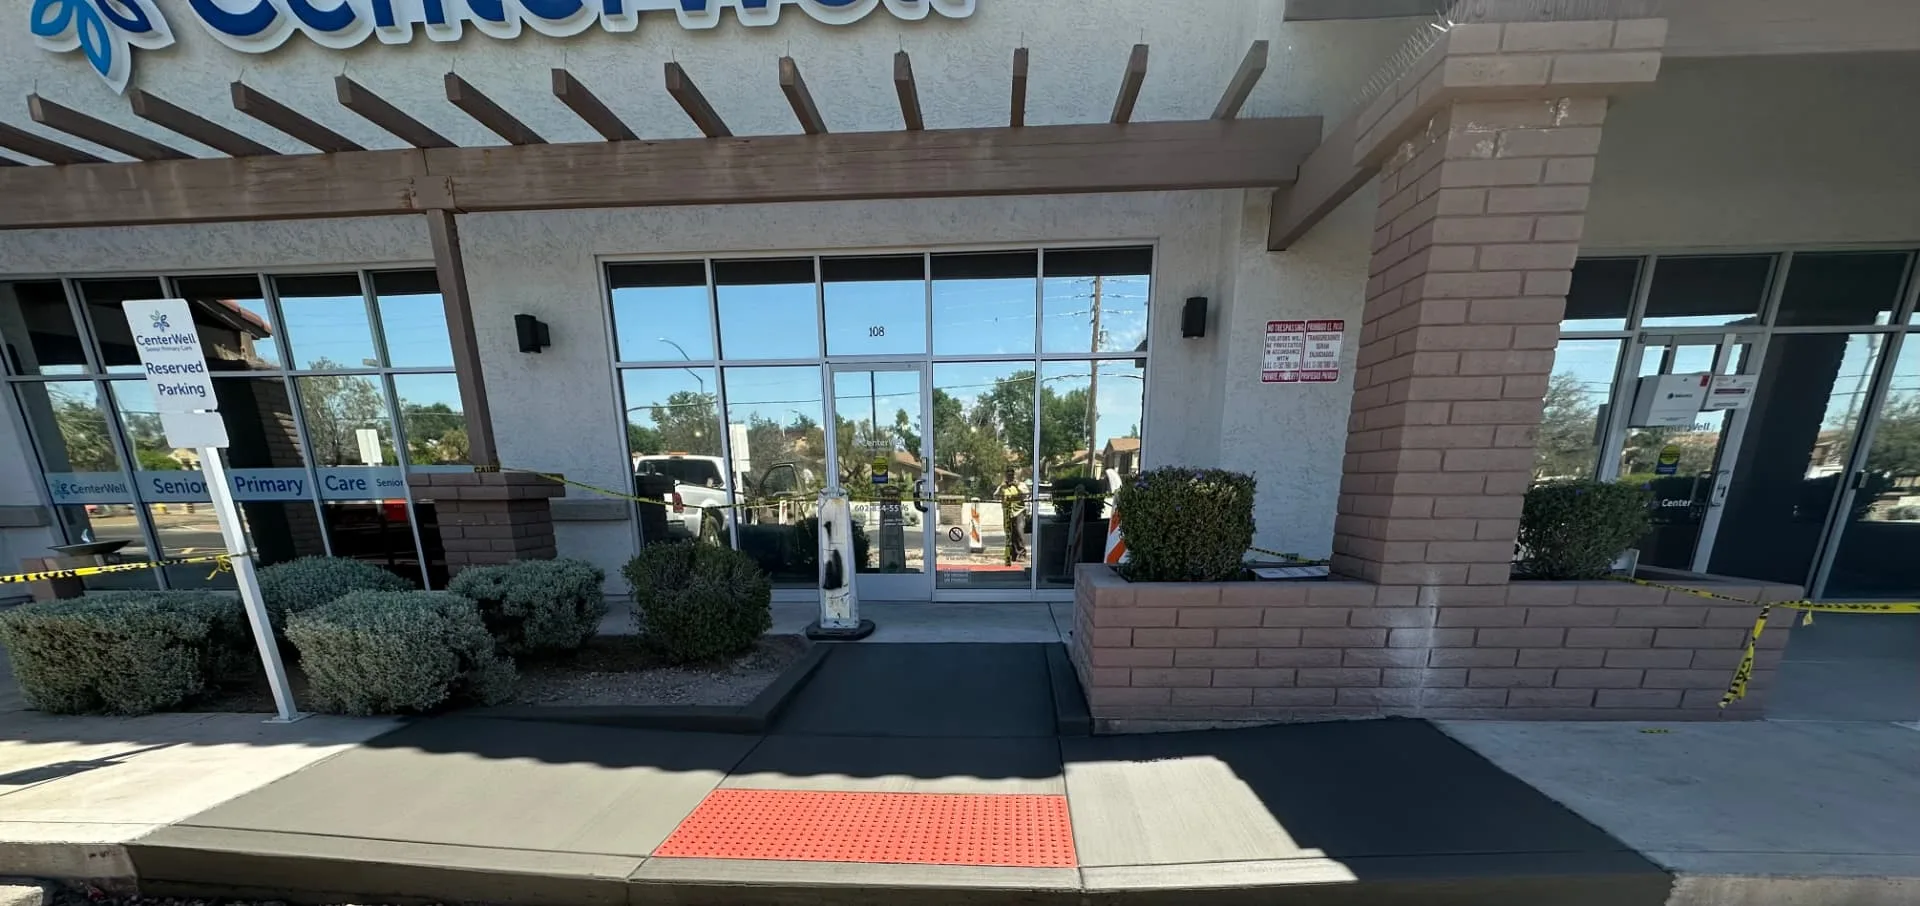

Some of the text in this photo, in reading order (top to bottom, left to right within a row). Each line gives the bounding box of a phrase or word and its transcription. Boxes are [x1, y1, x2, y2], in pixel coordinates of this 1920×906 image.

[869, 326, 885, 337] 108
[136, 333, 196, 346] CenterWell
[145, 361, 204, 375] Reserved
[157, 382, 206, 398] Parking
[70, 482, 127, 494] CenterWell
[153, 478, 208, 494] Senior
[234, 475, 303, 496] Primary
[325, 475, 367, 491] Care
